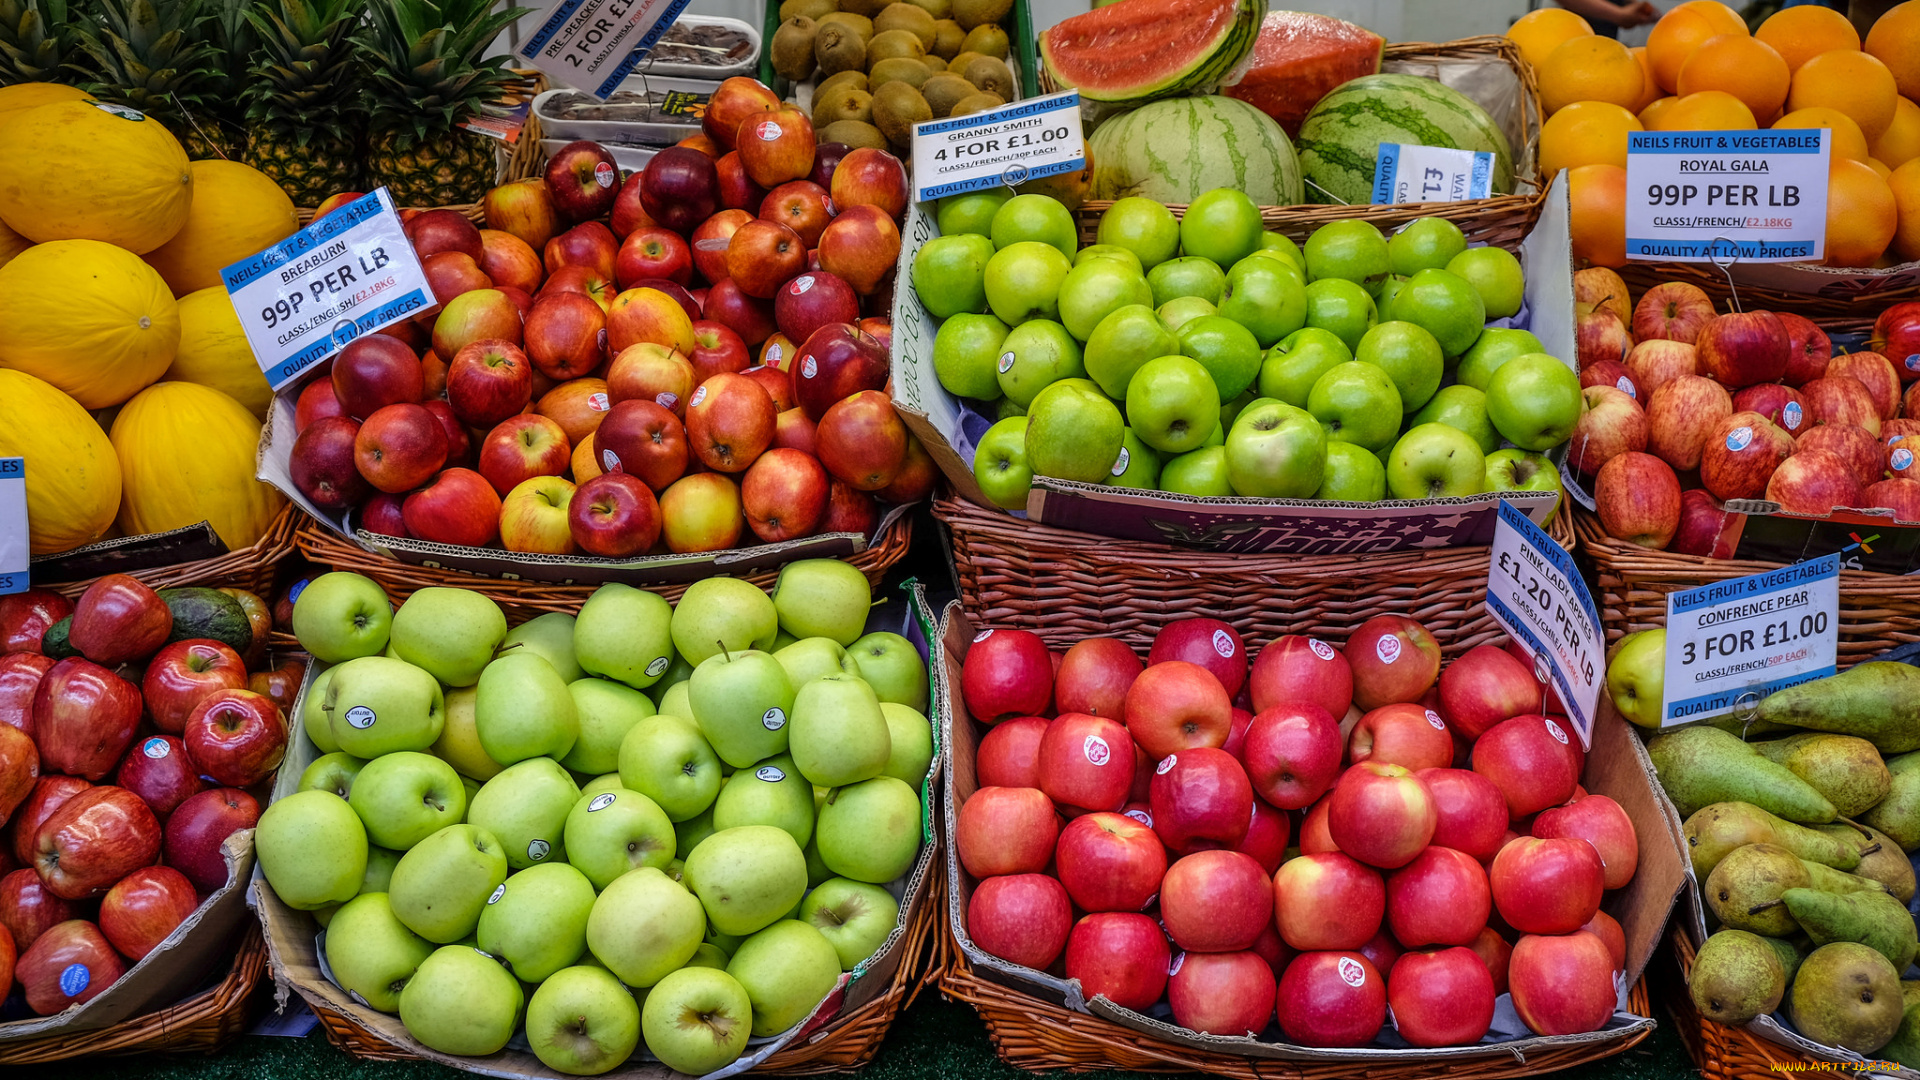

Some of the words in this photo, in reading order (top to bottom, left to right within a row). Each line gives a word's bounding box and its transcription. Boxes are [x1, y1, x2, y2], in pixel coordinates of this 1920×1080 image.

[521, 33, 545, 56] NEILS
[542, 8, 568, 34] FRUIT
[565, 0, 576, 9] &
[565, 54, 583, 67] 2
[576, 19, 615, 54] FOR
[643, 24, 665, 47] LOW
[545, 39, 565, 58] PRE
[918, 122, 949, 134] NEILS
[951, 116, 986, 129] FRUIT
[988, 113, 998, 121] &
[1000, 96, 1073, 119] VEGETABLES
[948, 126, 1000, 141] GRANNY
[1003, 117, 1043, 132] SMITH
[934, 149, 948, 161] 4
[955, 140, 1000, 158] FOR
[1007, 127, 1069, 149] £1.00
[1033, 146, 1057, 156] EACH
[1633, 137, 1669, 149] NEILS
[1673, 137, 1713, 148] FRUIT
[1717, 137, 1728, 147] &
[1732, 136, 1820, 148] VEGETABLES
[926, 181, 977, 197] QUALITY
[981, 176, 997, 186] AT
[1031, 162, 1073, 177] PRICES
[1378, 156, 1393, 204] QUALITY
[1680, 160, 1726, 171] ROYAL
[1731, 160, 1769, 171] GALA
[1648, 184, 1698, 206] 99P
[1707, 185, 1758, 206] PER
[1769, 185, 1801, 207] LB
[1653, 216, 1792, 229] CLASS1/FRENCH/£2.18KG
[228, 264, 262, 287] NEILS
[297, 237, 308, 249] &
[308, 197, 382, 242] VEGETABLES
[1641, 245, 1698, 257] QUALITY
[1701, 246, 1720, 257] AT
[1724, 246, 1755, 258] LOW
[1760, 246, 1807, 258] PRICES
[281, 240, 346, 283] BREABURN
[261, 291, 304, 329] 99P
[309, 263, 357, 302] PER
[358, 246, 390, 276] LB
[283, 342, 330, 378] QUALITY
[348, 317, 375, 340] LOW
[378, 297, 421, 325] PRICES
[1503, 507, 1531, 536] NEILS
[1533, 533, 1561, 564] FRUIT
[1520, 542, 1543, 569] PINK
[1545, 567, 1569, 598] LADY
[1569, 593, 1592, 641] APPLES
[1673, 591, 1705, 608] NEILS
[1708, 582, 1745, 600] FRUIT
[1747, 579, 1758, 591] &
[1761, 560, 1834, 588] VEGETABLES
[1498, 551, 1551, 611] £1.20
[1555, 604, 1580, 657] PER
[1581, 650, 1594, 687] LB
[1698, 599, 1773, 626] CONFRENCE
[1777, 591, 1809, 608] PEAR
[1682, 642, 1696, 665] 3
[1705, 629, 1755, 659] FOR
[1763, 611, 1827, 647] £1.00
[1495, 603, 1534, 649] QUALITY
[1563, 687, 1586, 728] PRICES
[1695, 654, 1783, 682] CLASS1/FRENCH/50P
[1785, 650, 1807, 662] EACH
[1674, 696, 1729, 718] QUALITY
